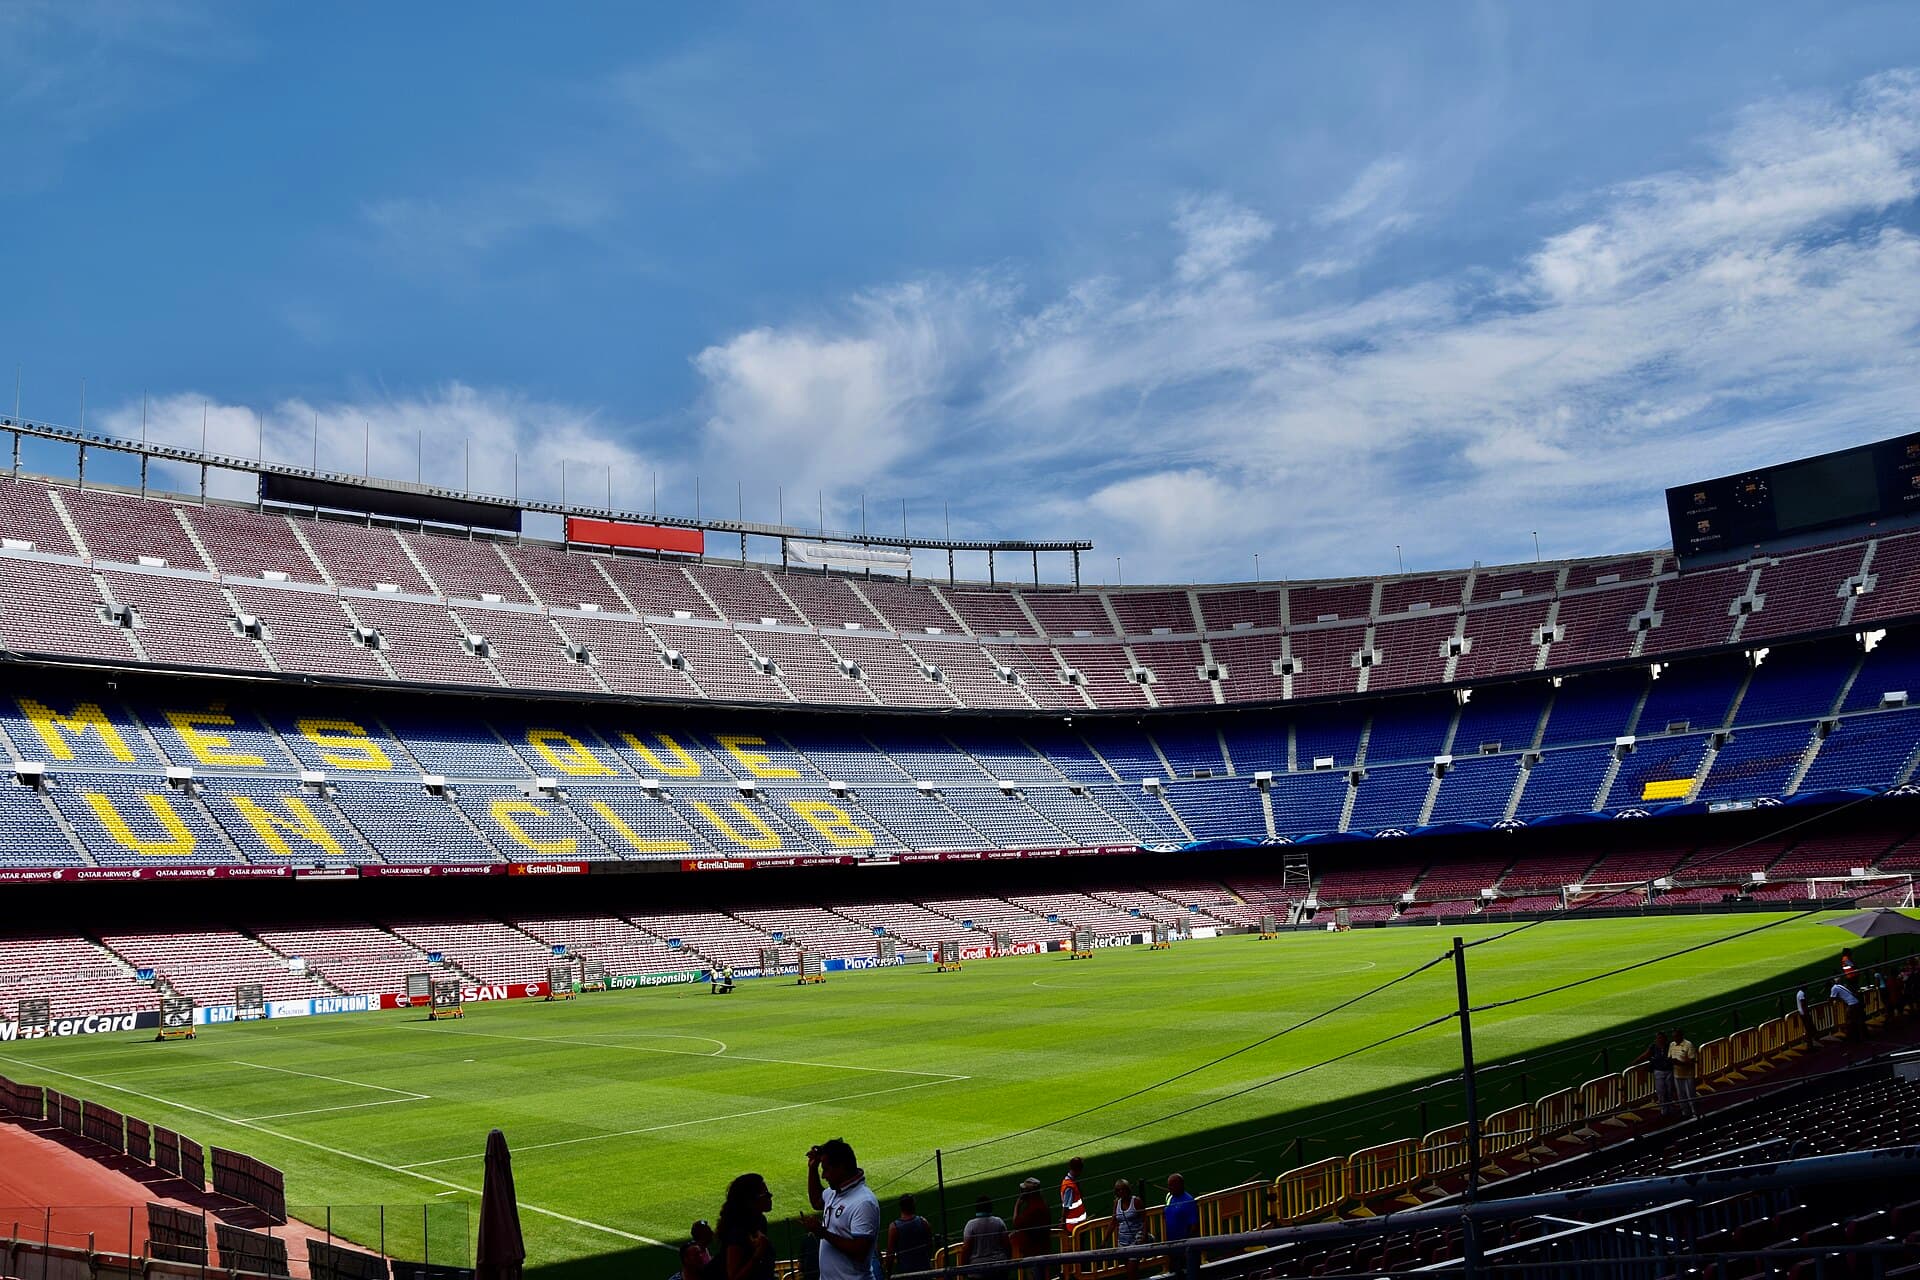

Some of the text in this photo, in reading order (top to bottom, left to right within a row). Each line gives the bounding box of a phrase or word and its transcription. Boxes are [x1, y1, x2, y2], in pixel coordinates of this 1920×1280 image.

[525, 728, 800, 778] QUE
[84, 792, 876, 855] UN CLUB
[526, 863, 580, 873] Estrella Damm
[697, 860, 744, 870] Estrella Damm
[77, 871, 101, 879] QATAR
[156, 869, 178, 877] QATAR
[229, 868, 250, 876] QATAR
[1090, 934, 1131, 949] sterCard
[776, 964, 799, 975] LEAGU
[611, 972, 695, 989] Enjoy Responsibly
[315, 996, 366, 1013] GAZPROM
[0, 1012, 138, 1041] MasterCard
